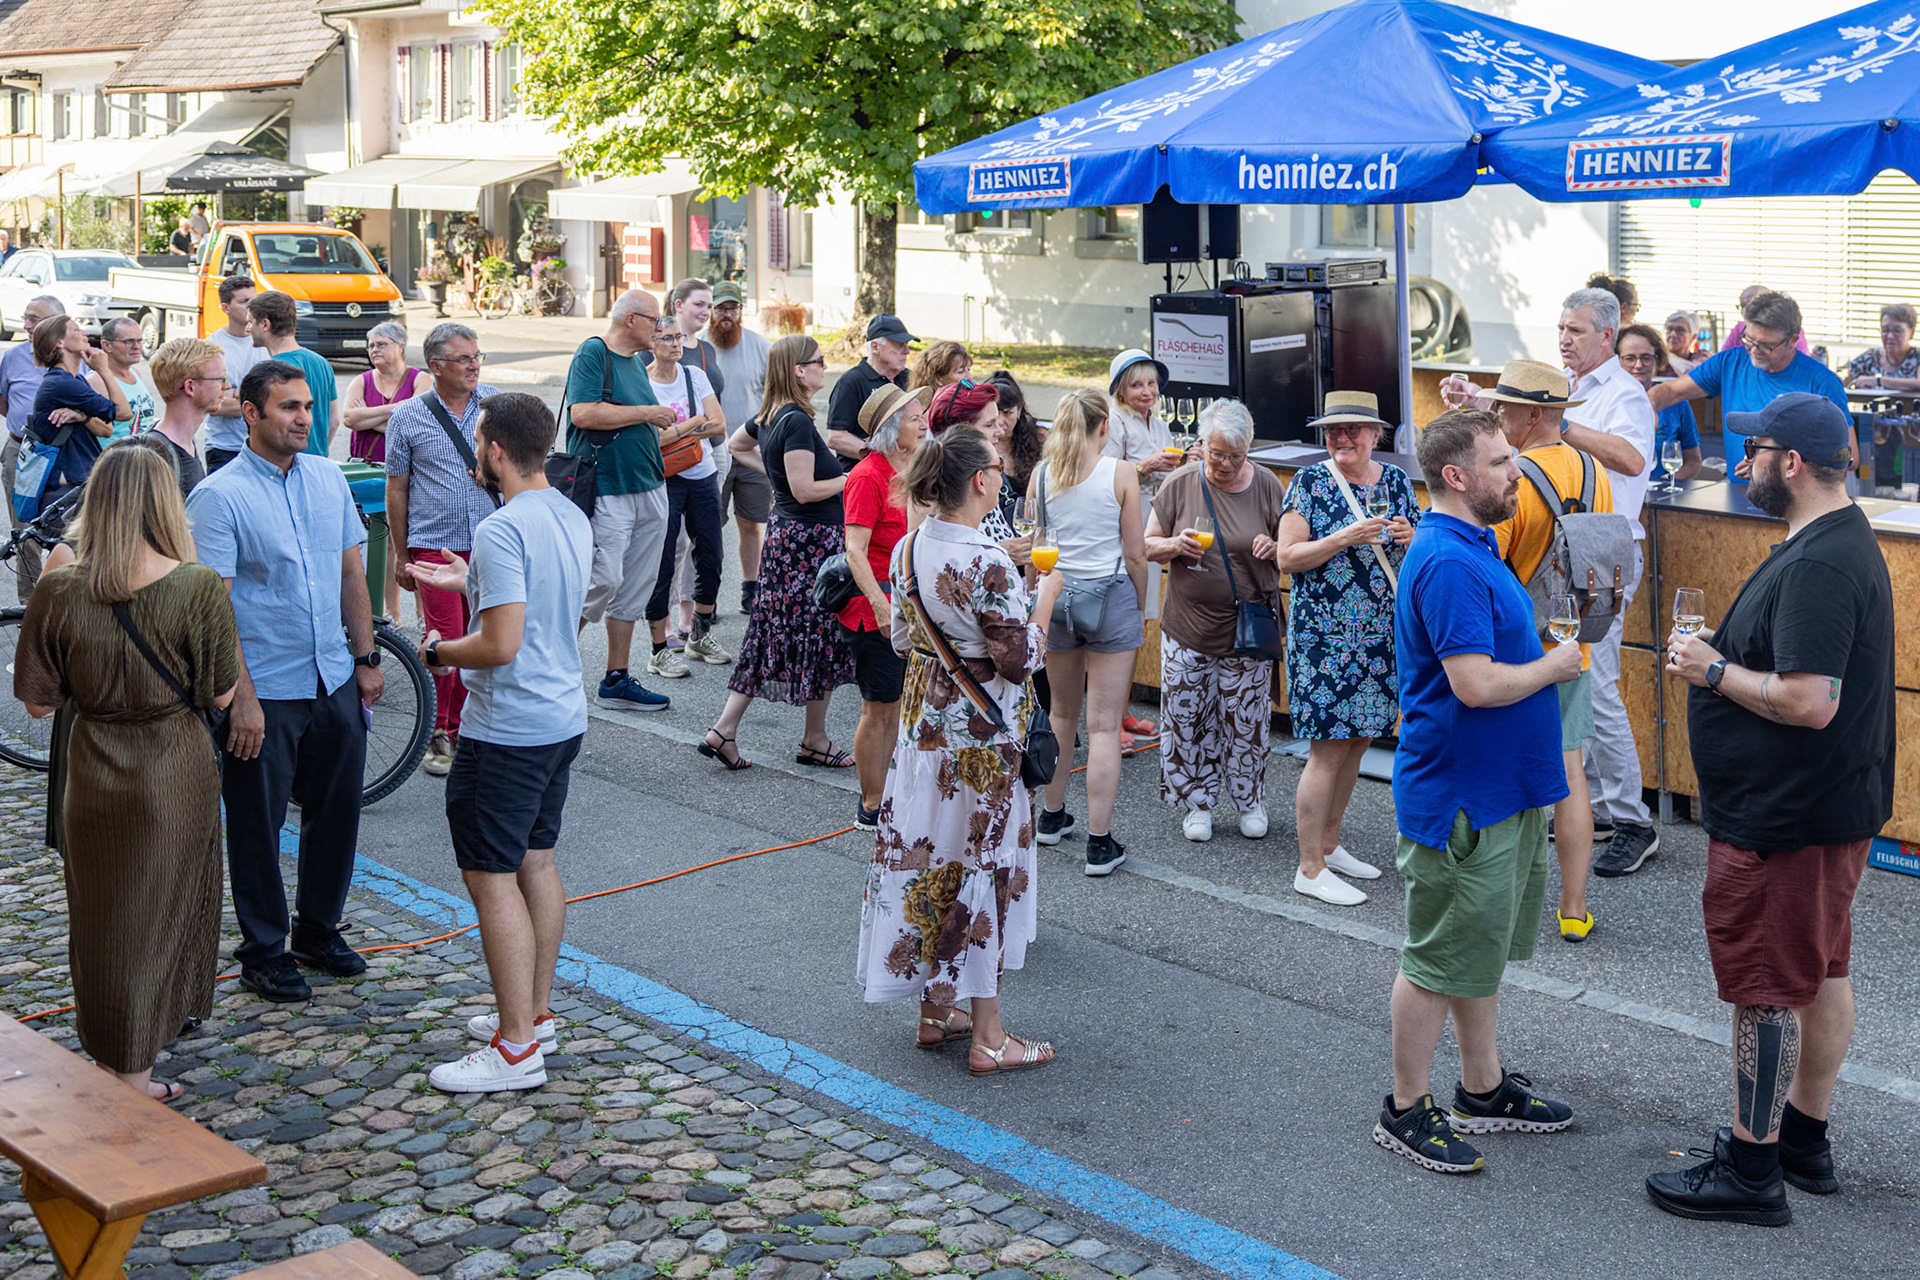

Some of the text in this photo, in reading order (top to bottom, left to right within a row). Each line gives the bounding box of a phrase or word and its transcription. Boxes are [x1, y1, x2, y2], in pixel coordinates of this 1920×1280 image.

[1238, 152, 1398, 190] henniez.ch
[1583, 147, 1712, 175] HENNIEZ
[979, 166, 1060, 190] HENNIEZ
[1157, 339, 1225, 356] FLÄSCHEHALS
